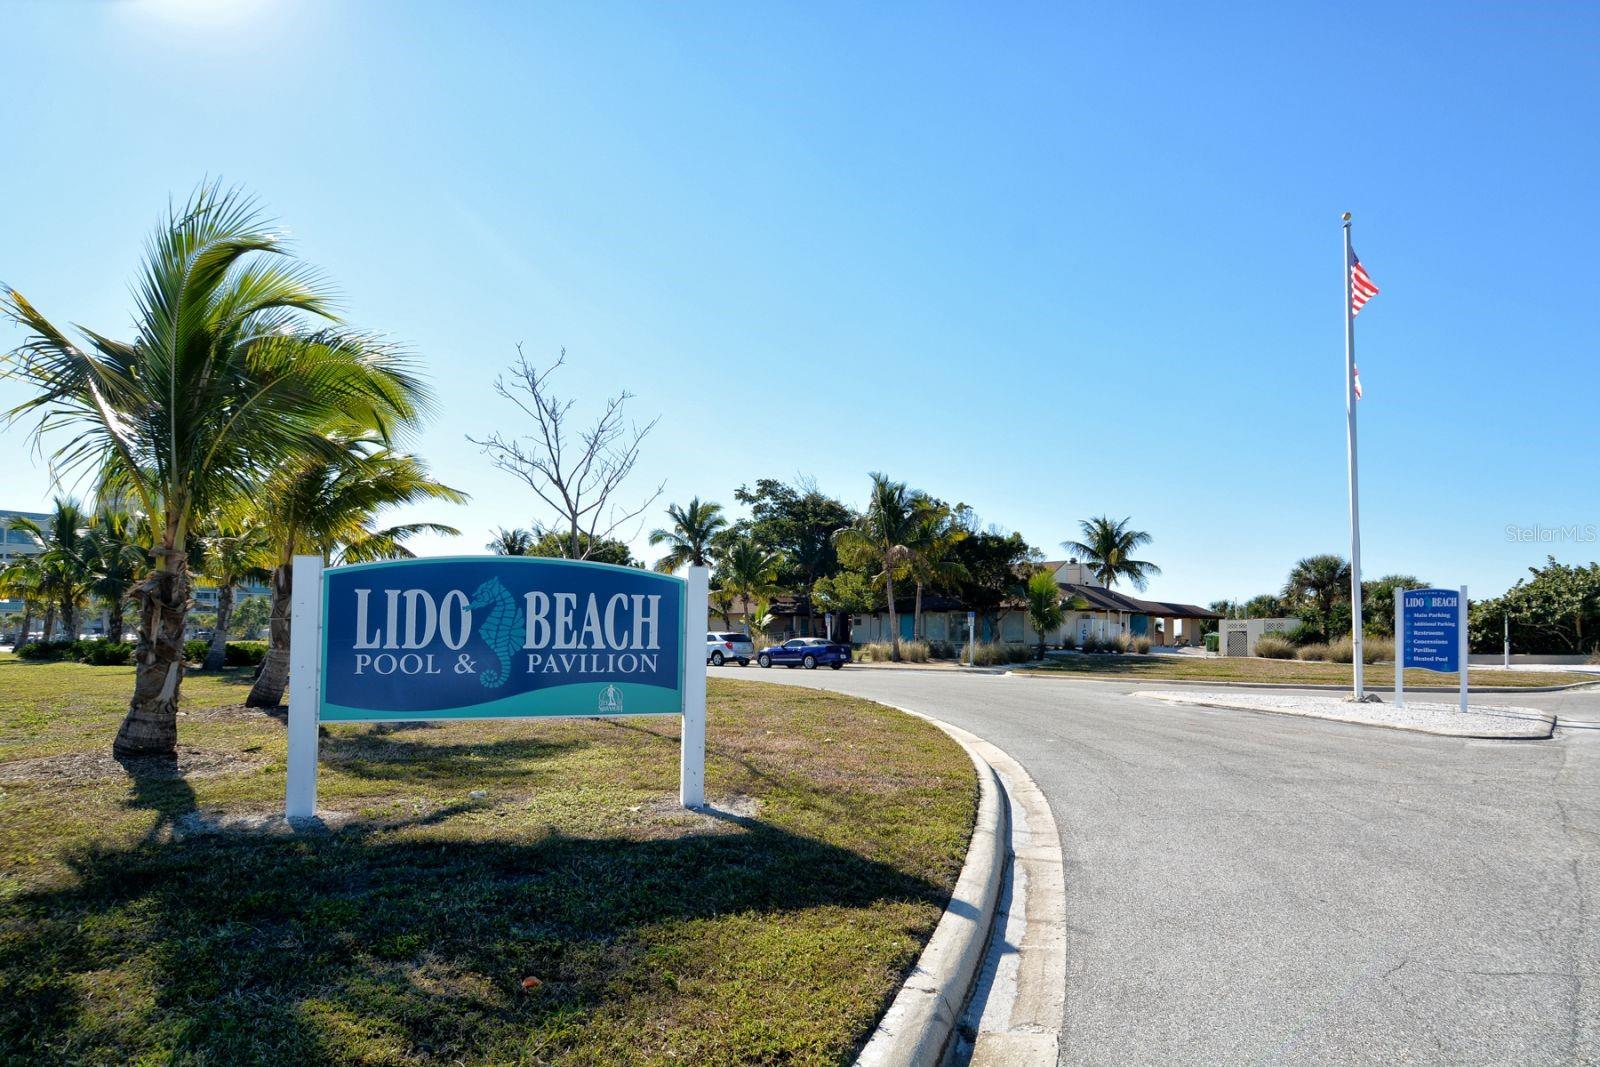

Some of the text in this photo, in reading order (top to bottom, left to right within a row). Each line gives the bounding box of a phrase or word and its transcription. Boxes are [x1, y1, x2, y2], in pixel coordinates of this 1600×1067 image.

[1405, 597, 1457, 607] LIDO BEACH
[353, 589, 662, 650] LIDO BEACH
[353, 653, 659, 675] POOL & PAVILION
